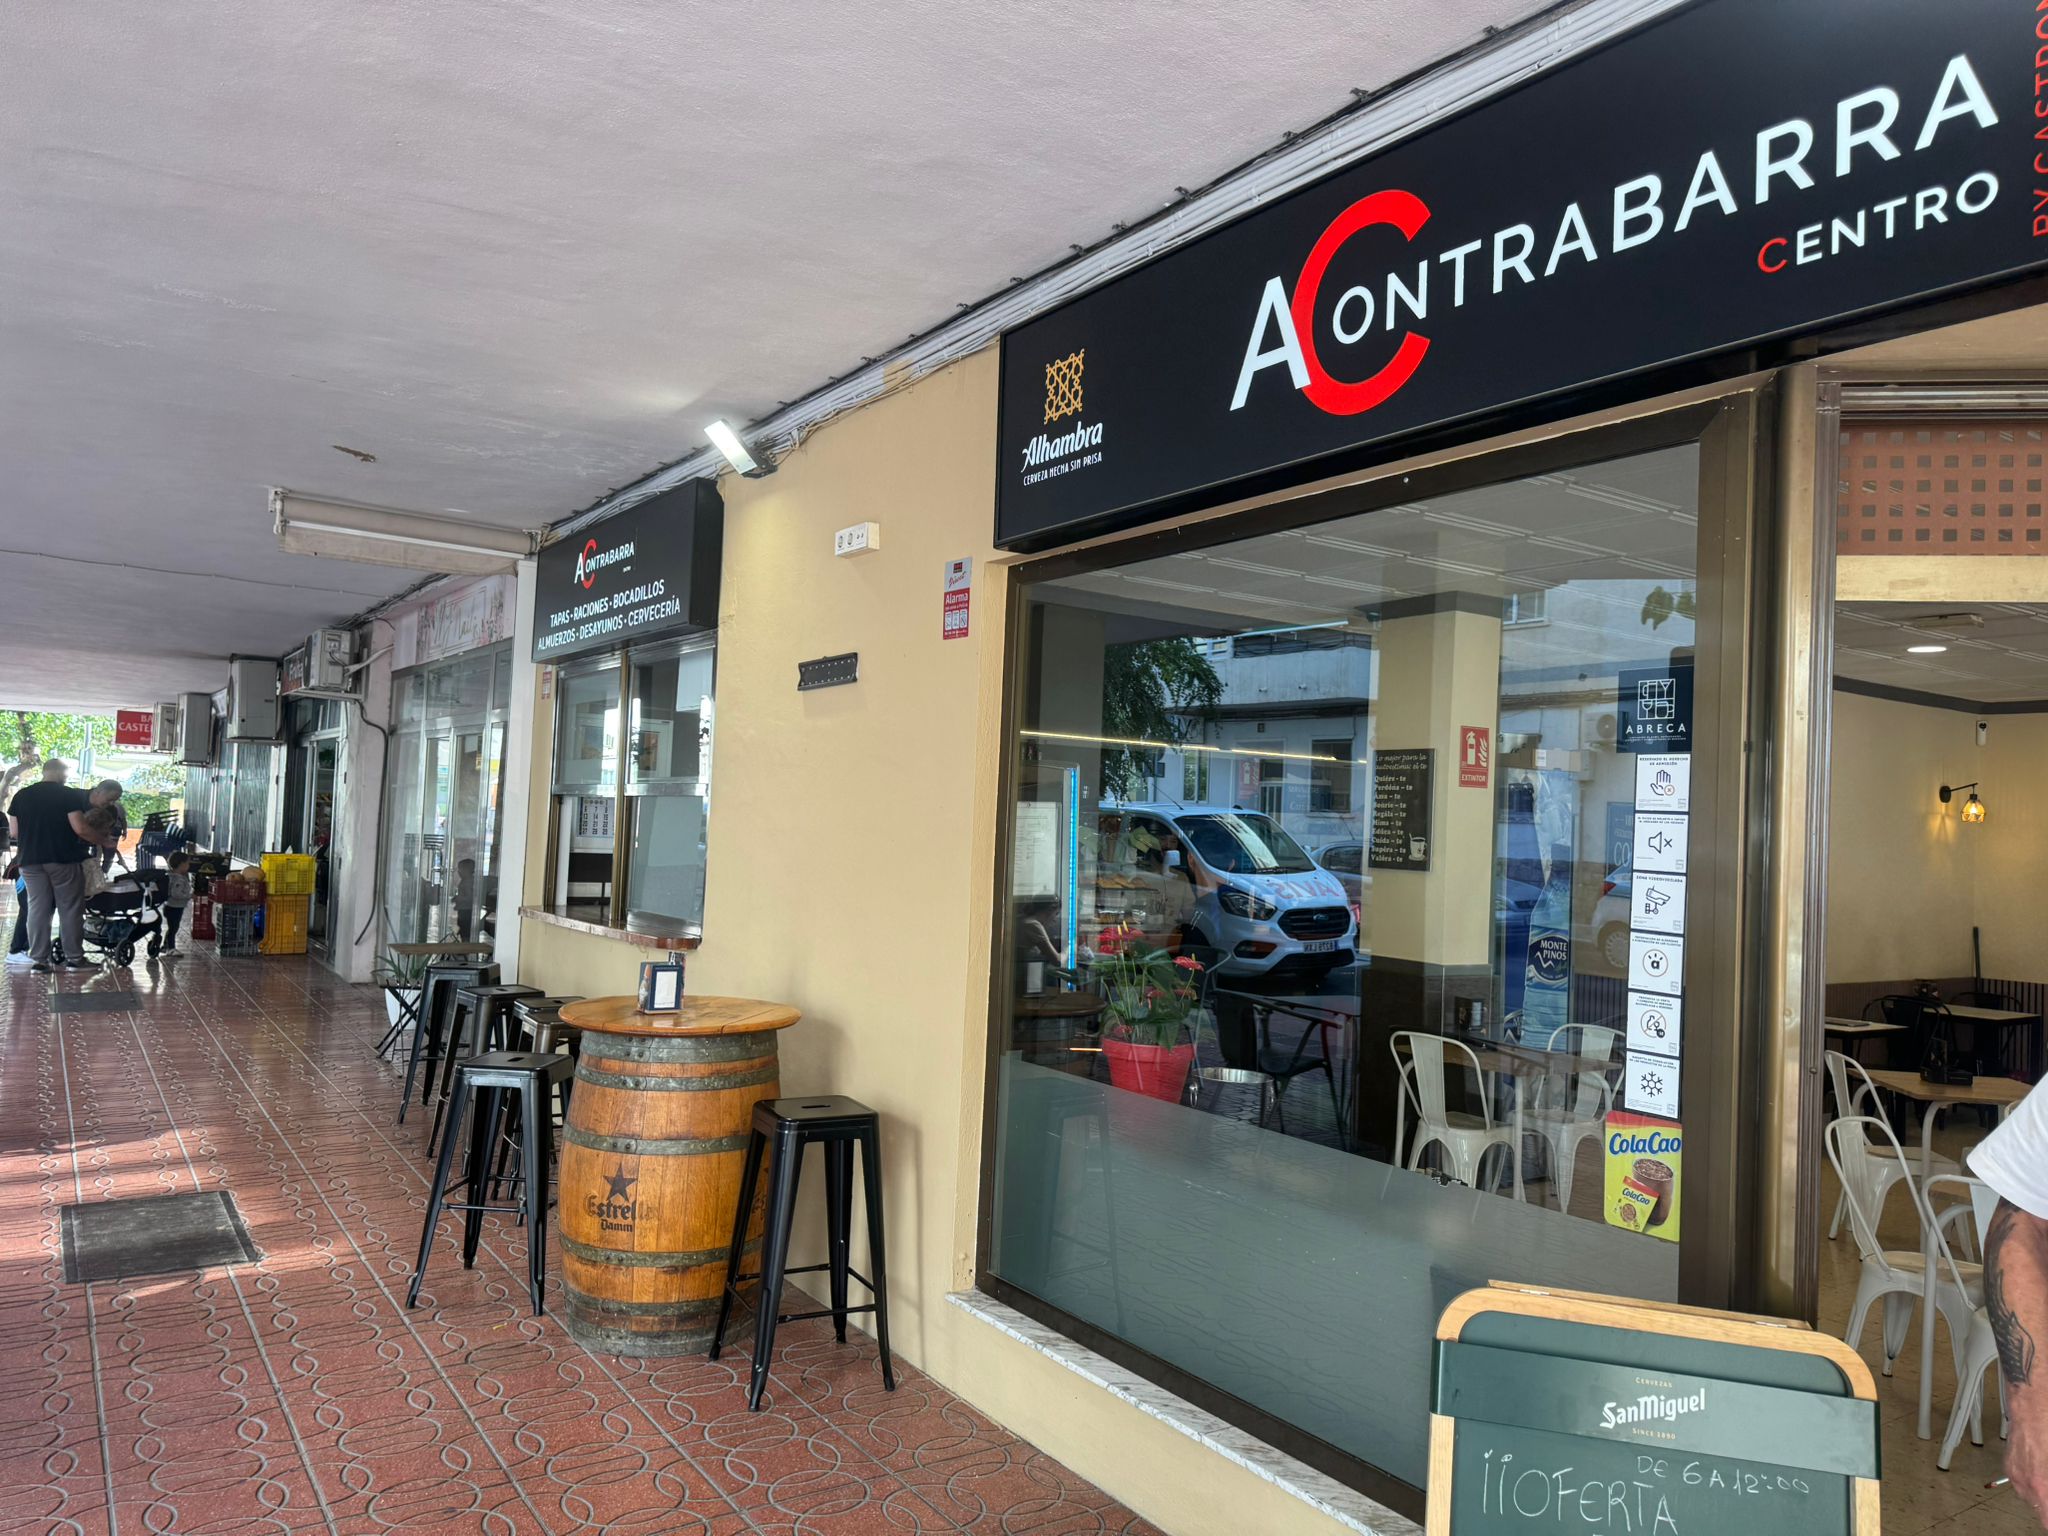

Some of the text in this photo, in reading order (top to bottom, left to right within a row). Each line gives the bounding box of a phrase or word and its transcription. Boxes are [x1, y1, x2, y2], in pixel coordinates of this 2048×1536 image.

[1758, 171, 1999, 274] CENTRO
[1021, 421, 1103, 473] Alhambra
[1023, 452, 1102, 486] CERVEZA HECHA SIN PRISA
[550, 579, 664, 628] TAPAS RACIONES BOCADILLOS
[946, 592, 968, 605] Alarma
[538, 595, 680, 650] ALMUERZOS DESAYUNOS CERVECERÍA
[118, 722, 152, 732] CASTE
[1626, 722, 1686, 734] ABRECA
[1462, 774, 1486, 782] EXTINTOR
[1540, 940, 1567, 951] MONTE
[1543, 950, 1567, 960] PINOS
[1609, 1132, 1682, 1155] ColaCao
[1622, 1188, 1650, 1205] ColaCao
[601, 1219, 632, 1232] Damm
[1635, 1377, 1672, 1388] CERVEZAS
[1632, 1428, 1676, 1440] SINCE 1890
[1638, 1456, 1669, 1478] DE
[1682, 1461, 1703, 1484] 6
[1709, 1471, 1725, 1489] A
